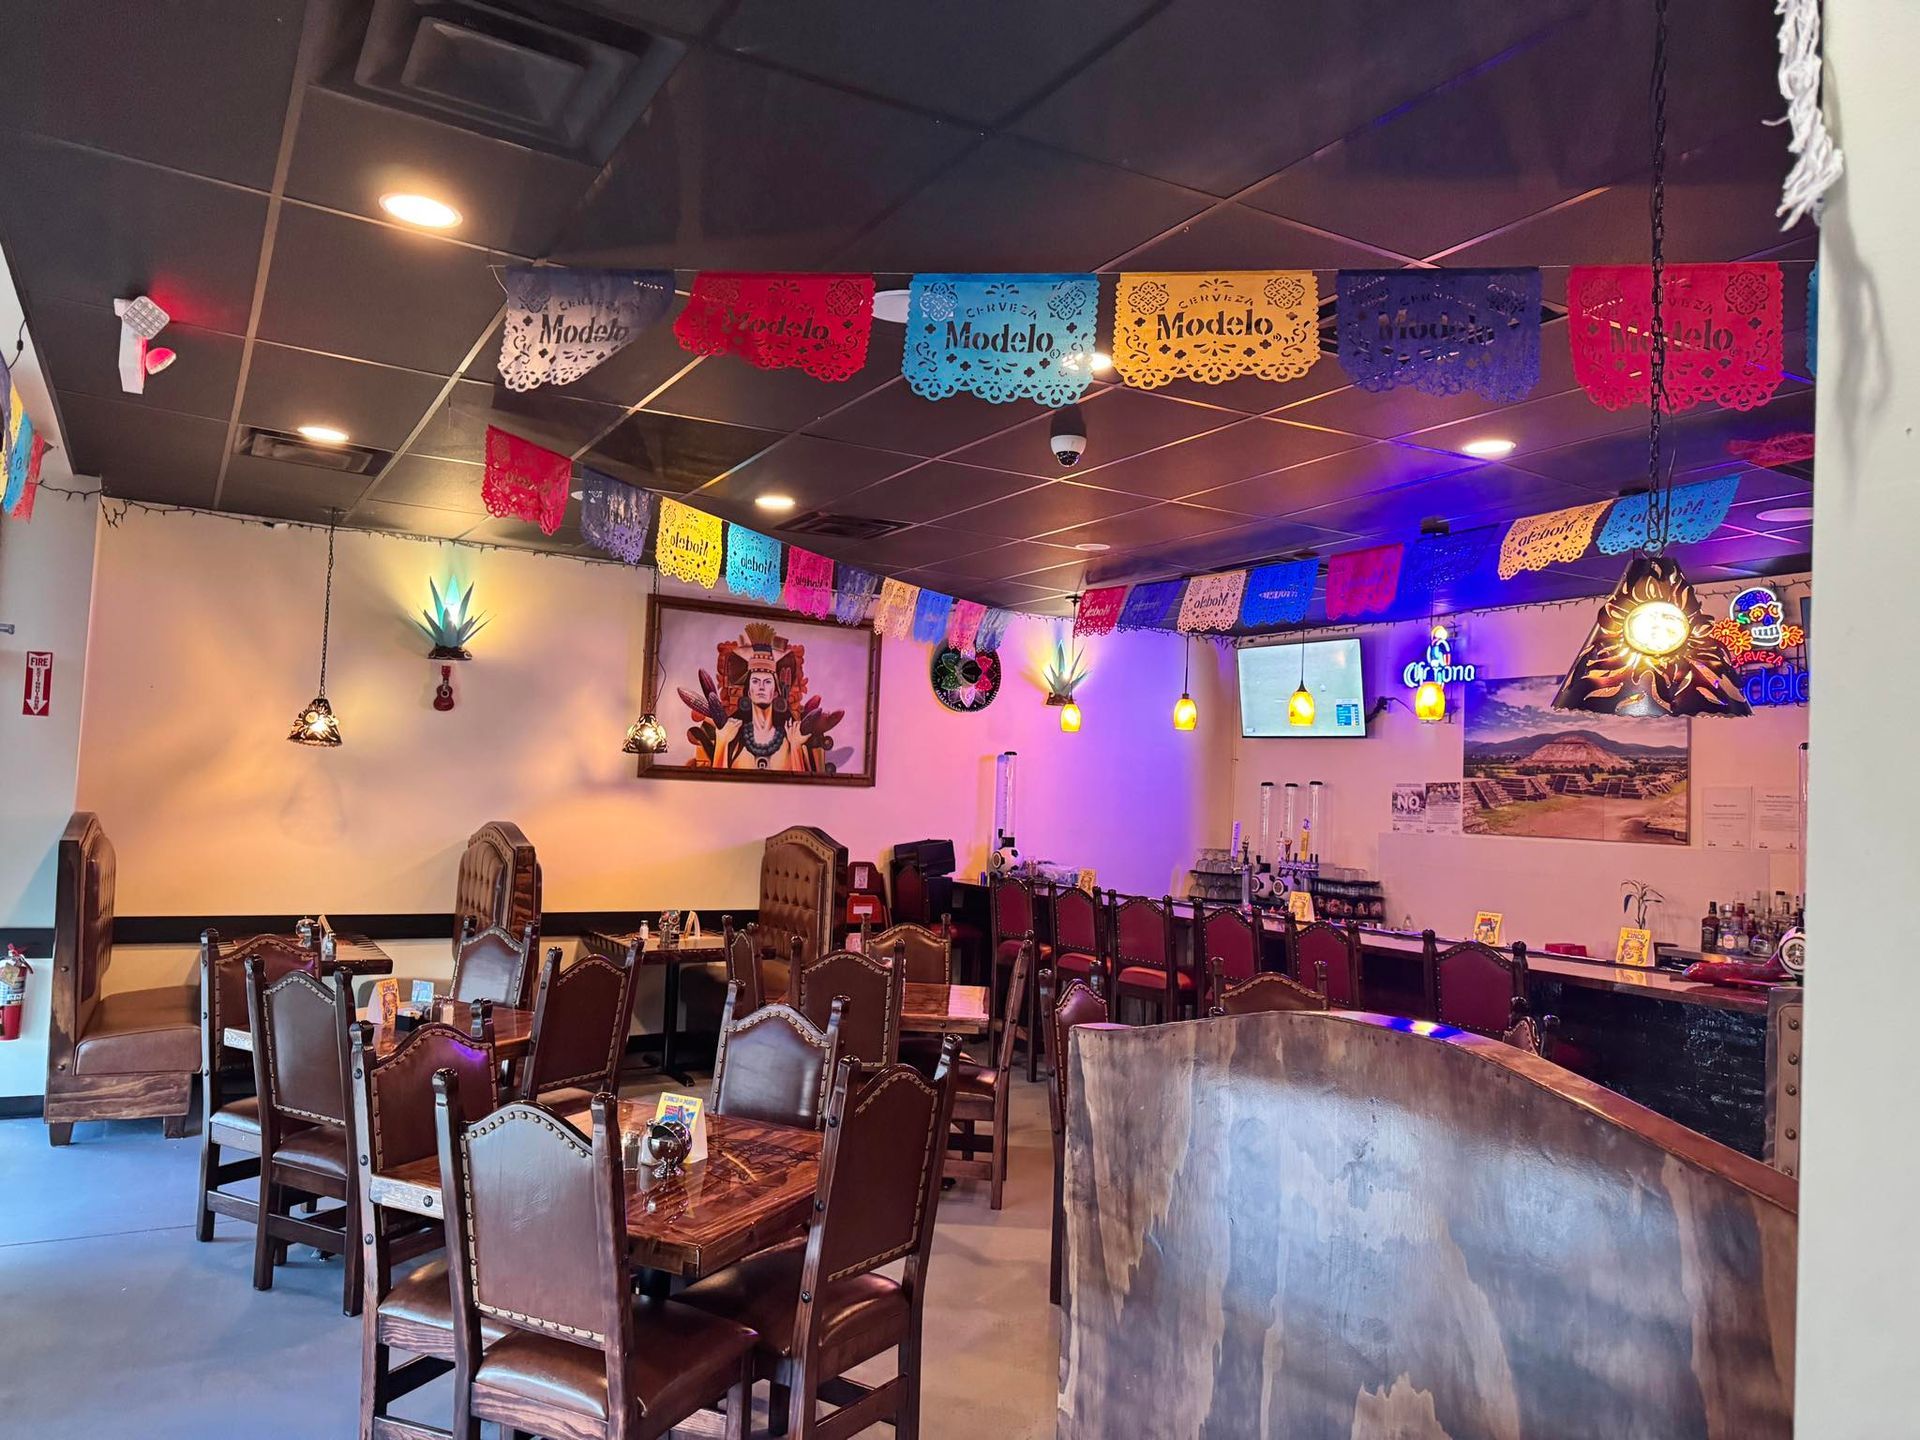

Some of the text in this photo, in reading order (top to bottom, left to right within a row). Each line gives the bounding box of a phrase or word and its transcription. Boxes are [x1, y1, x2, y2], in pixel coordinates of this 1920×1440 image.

[966, 302, 1037, 320] CERVEZA
[1178, 294, 1254, 309] CERVEZA
[539, 314, 630, 345] Modelo
[721, 305, 830, 340] Modelo
[1156, 309, 1274, 341] Modelo
[944, 321, 1054, 353] Modelo
[30, 657, 49, 667] FIRE
[1396, 795, 1421, 809] NO
